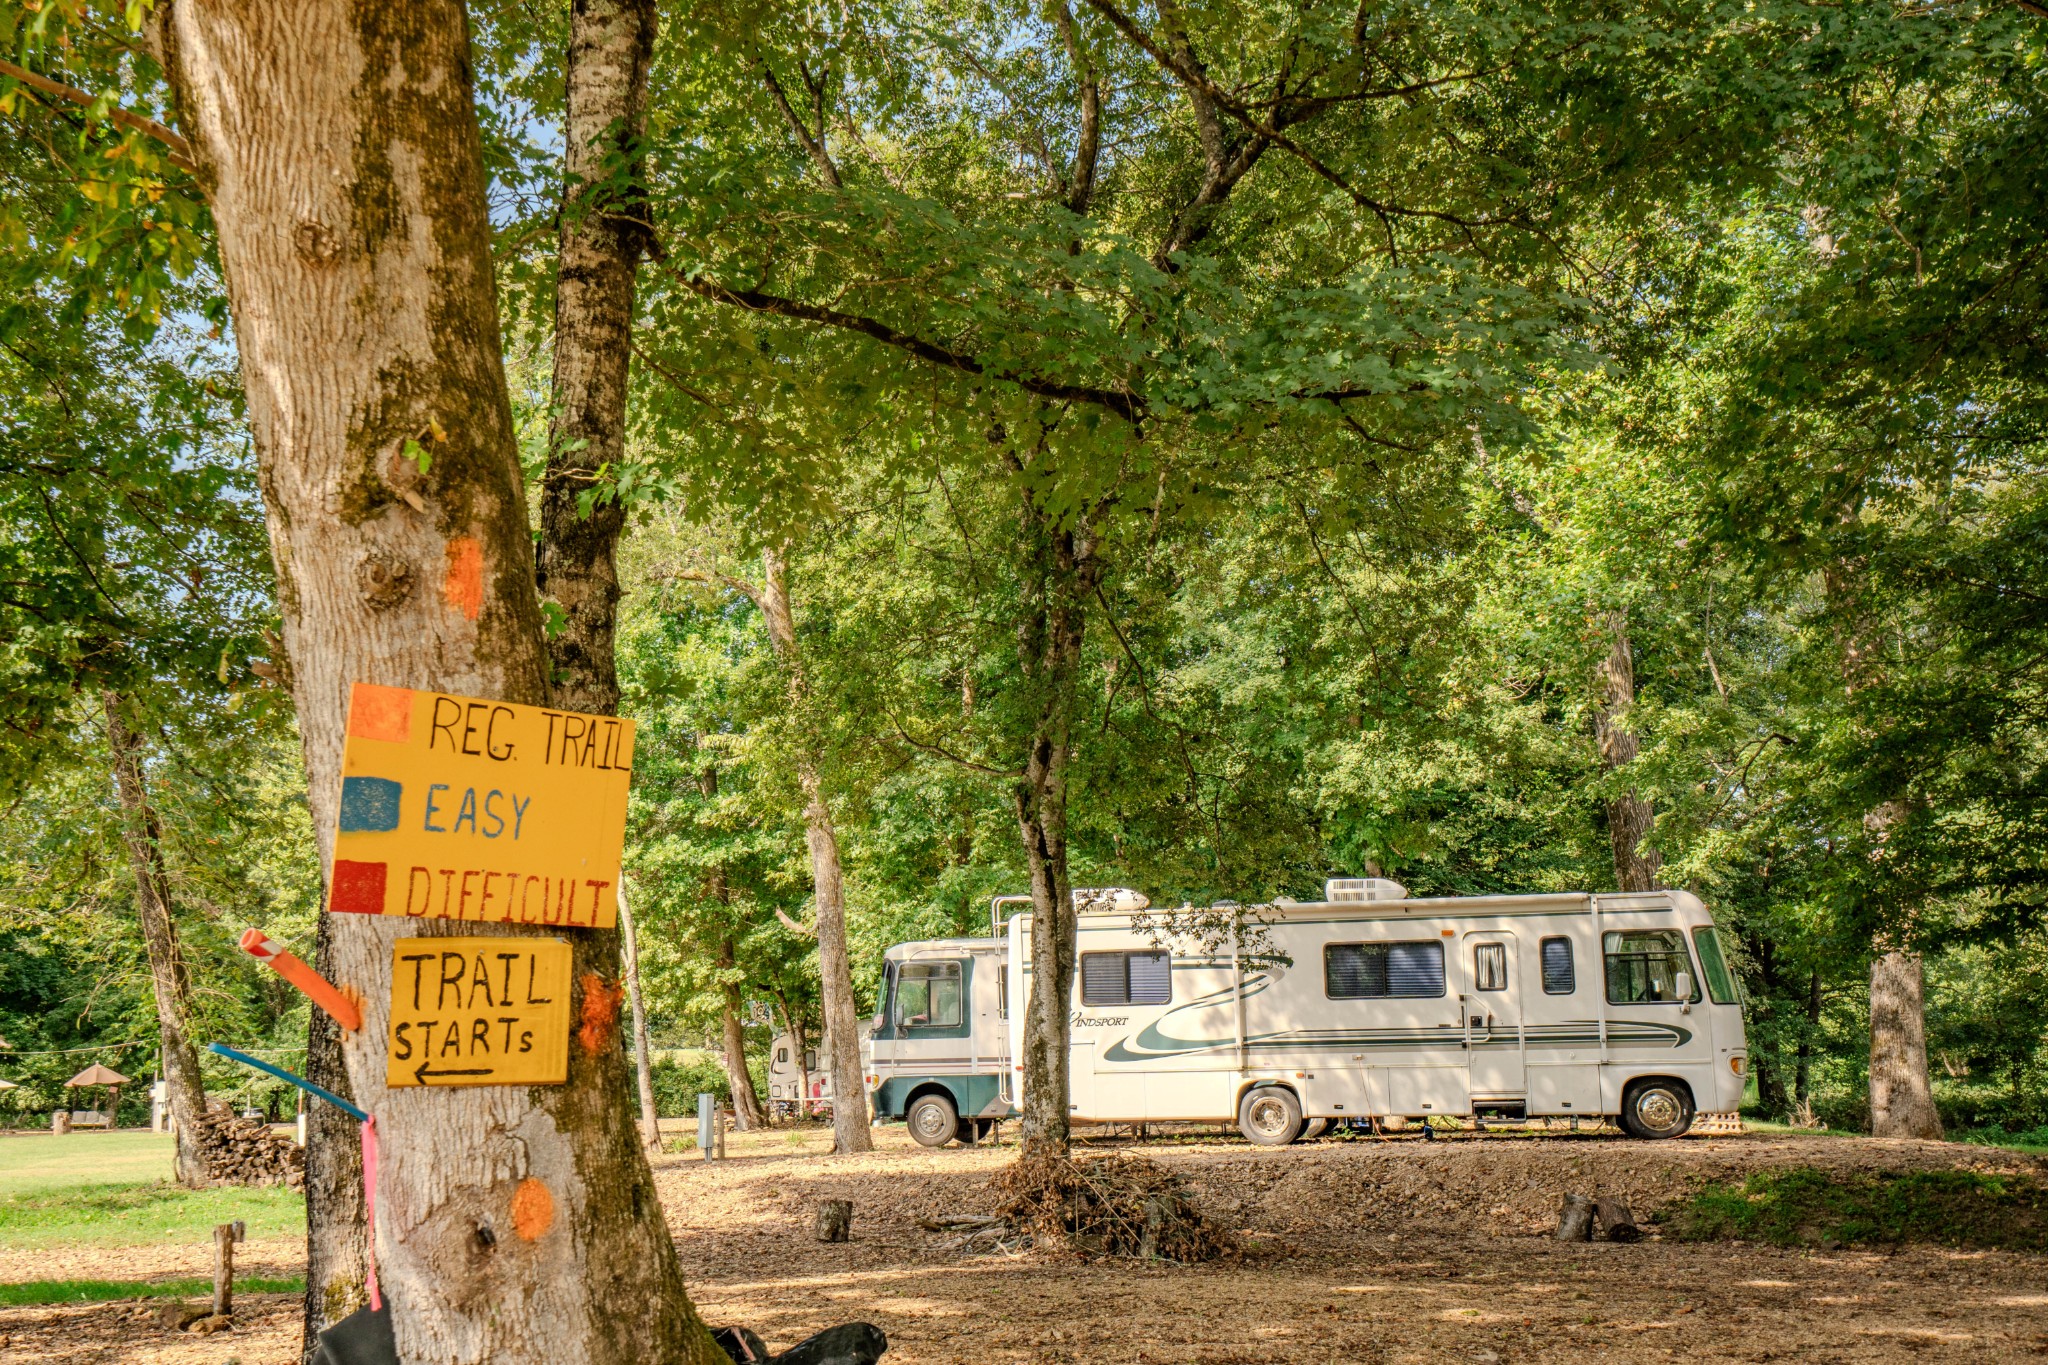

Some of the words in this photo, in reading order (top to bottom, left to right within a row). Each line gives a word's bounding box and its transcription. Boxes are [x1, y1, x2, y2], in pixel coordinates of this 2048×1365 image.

[429, 696, 518, 762] REG.
[541, 711, 630, 771] TRAIL
[423, 783, 531, 840] EASY
[406, 866, 610, 927] DIFFICULT
[401, 952, 552, 1011] TRAIL
